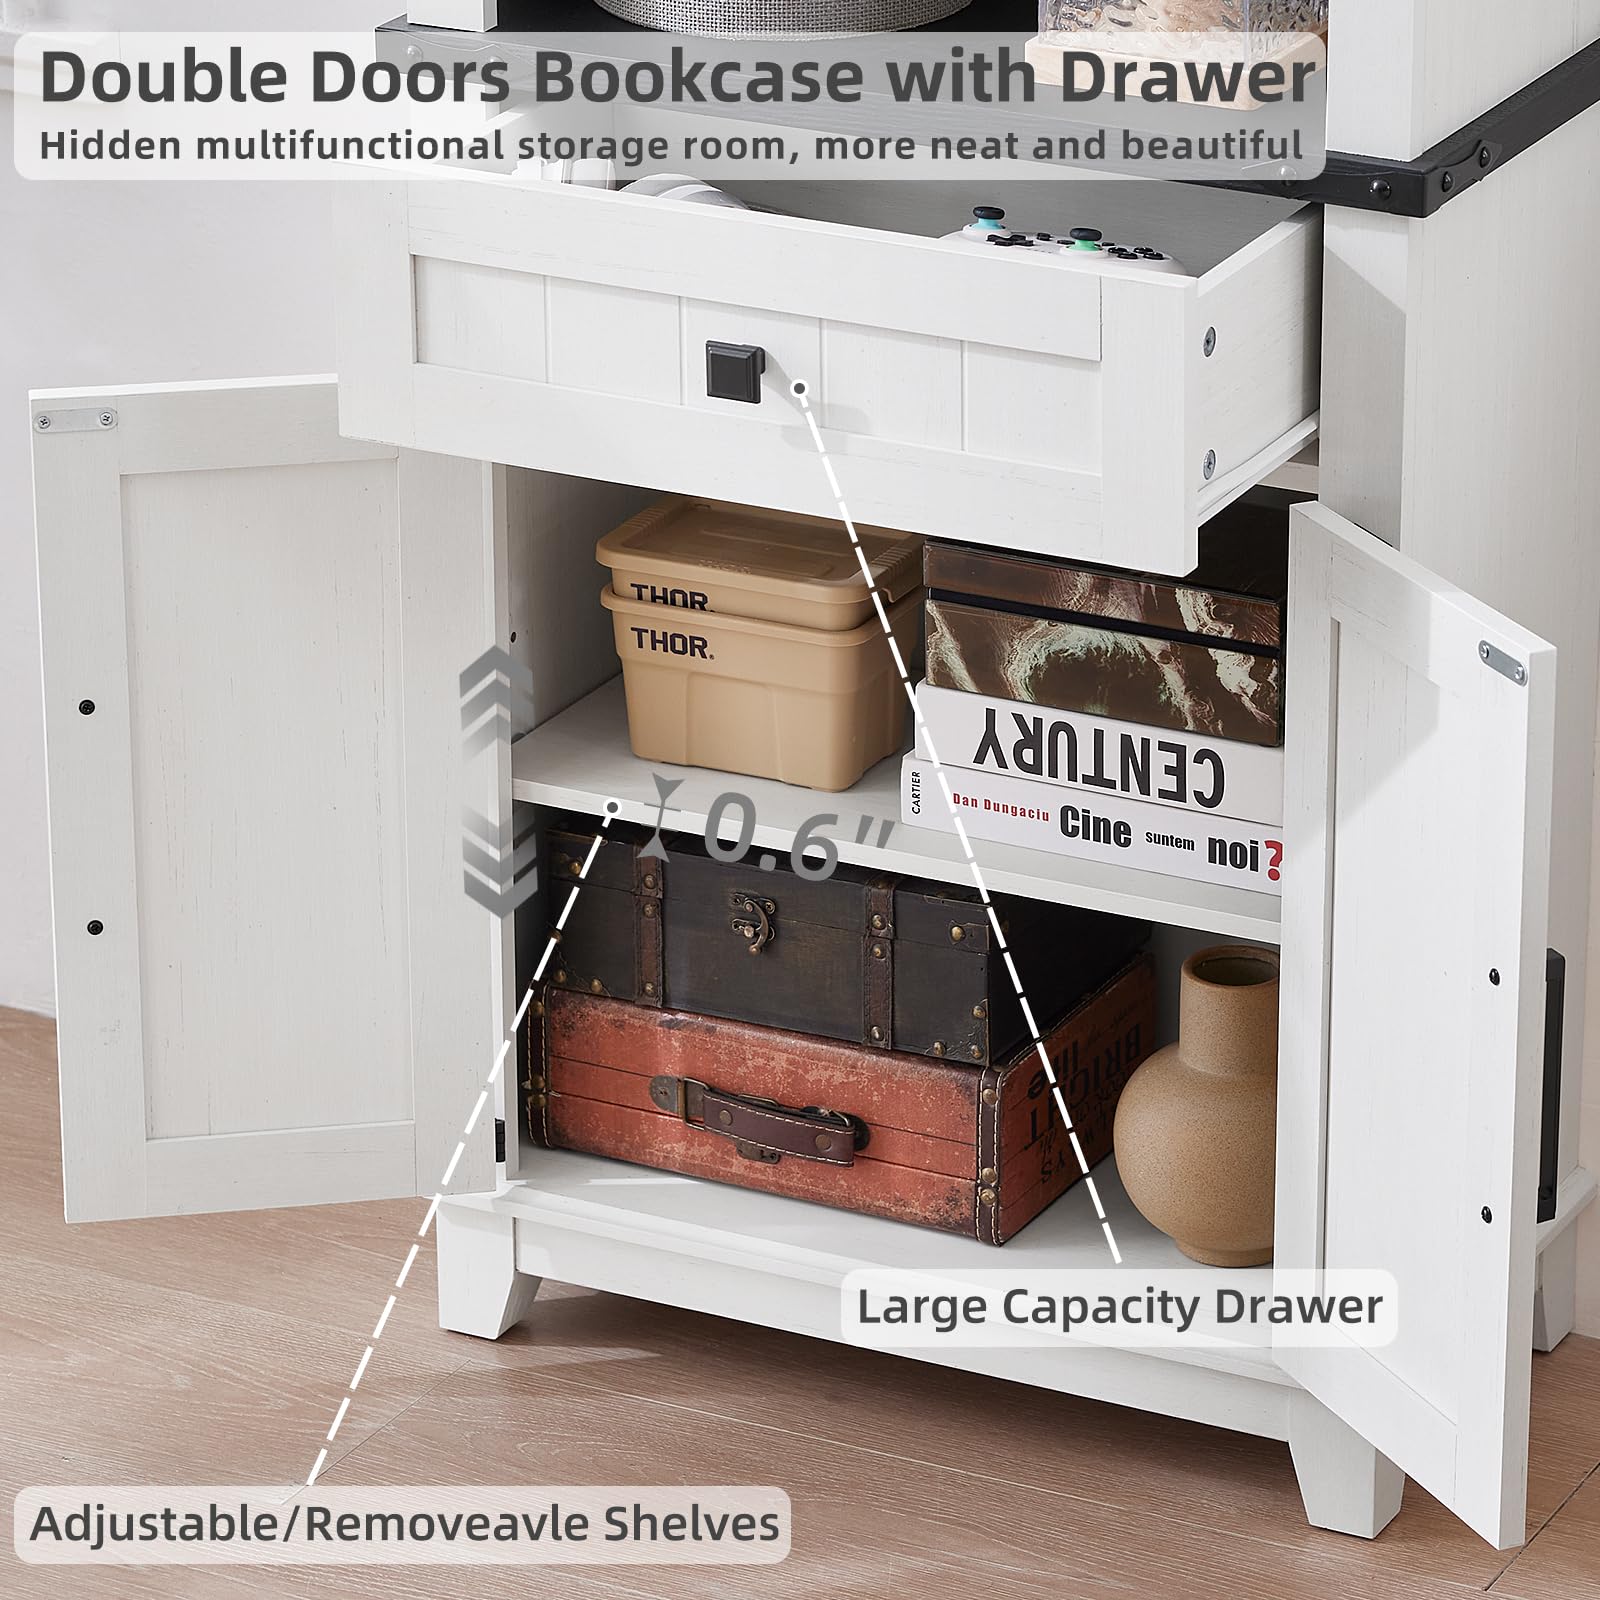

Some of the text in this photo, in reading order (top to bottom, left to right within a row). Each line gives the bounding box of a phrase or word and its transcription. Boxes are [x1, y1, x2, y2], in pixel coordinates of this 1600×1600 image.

[973, 707, 1225, 808] CENTURY
[911, 771, 921, 815] CARTIER
[953, 793, 1049, 822] Dan Dungaciu
[1060, 804, 1283, 881] Cine suntem noi?
